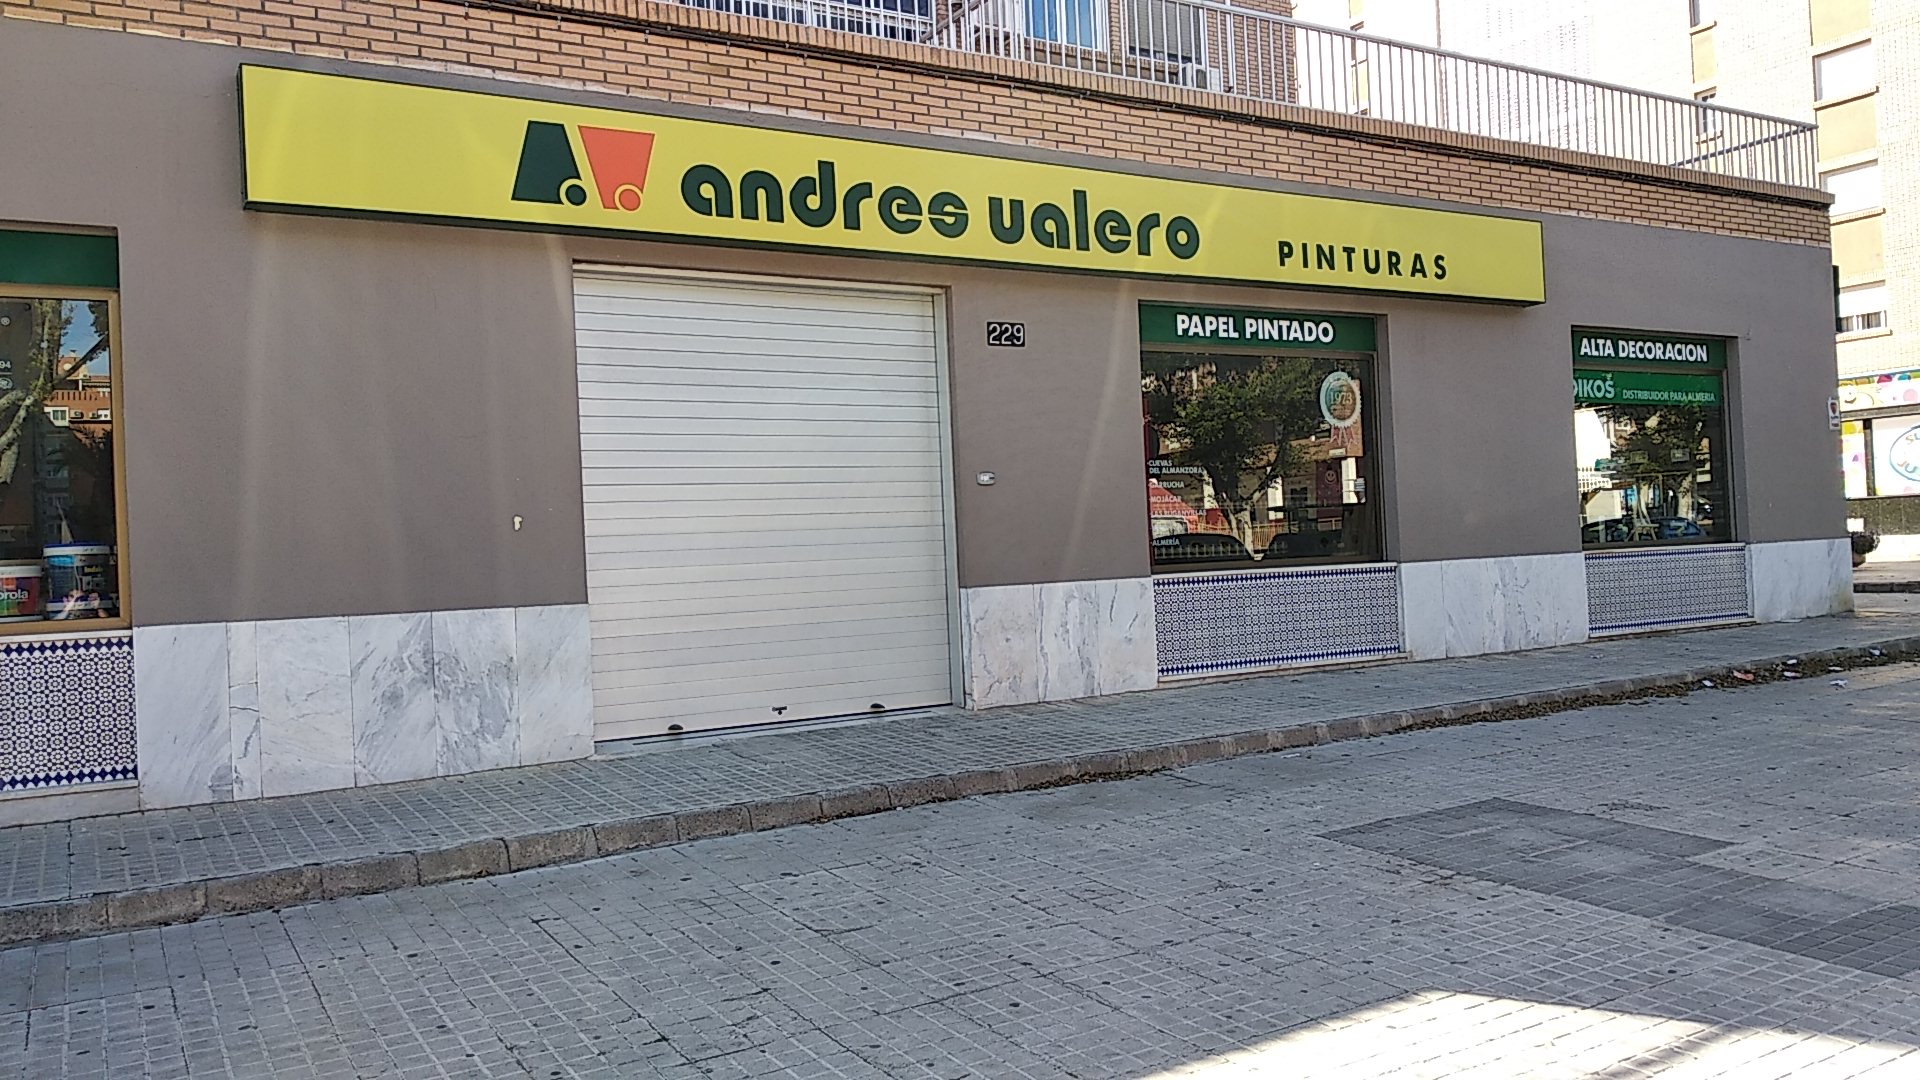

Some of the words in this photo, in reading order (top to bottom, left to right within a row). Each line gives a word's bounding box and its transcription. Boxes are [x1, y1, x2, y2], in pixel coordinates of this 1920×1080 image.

[681, 160, 969, 239] andres
[1277, 239, 1448, 280] PINTURAS
[988, 323, 1025, 345] 229
[1176, 314, 1240, 339] PAPEL
[1244, 318, 1335, 343] PINTADO
[1580, 337, 1616, 358] ALTA
[1618, 340, 1708, 363] DECORACION
[1622, 389, 1669, 401] DISTRIBUIDOR
